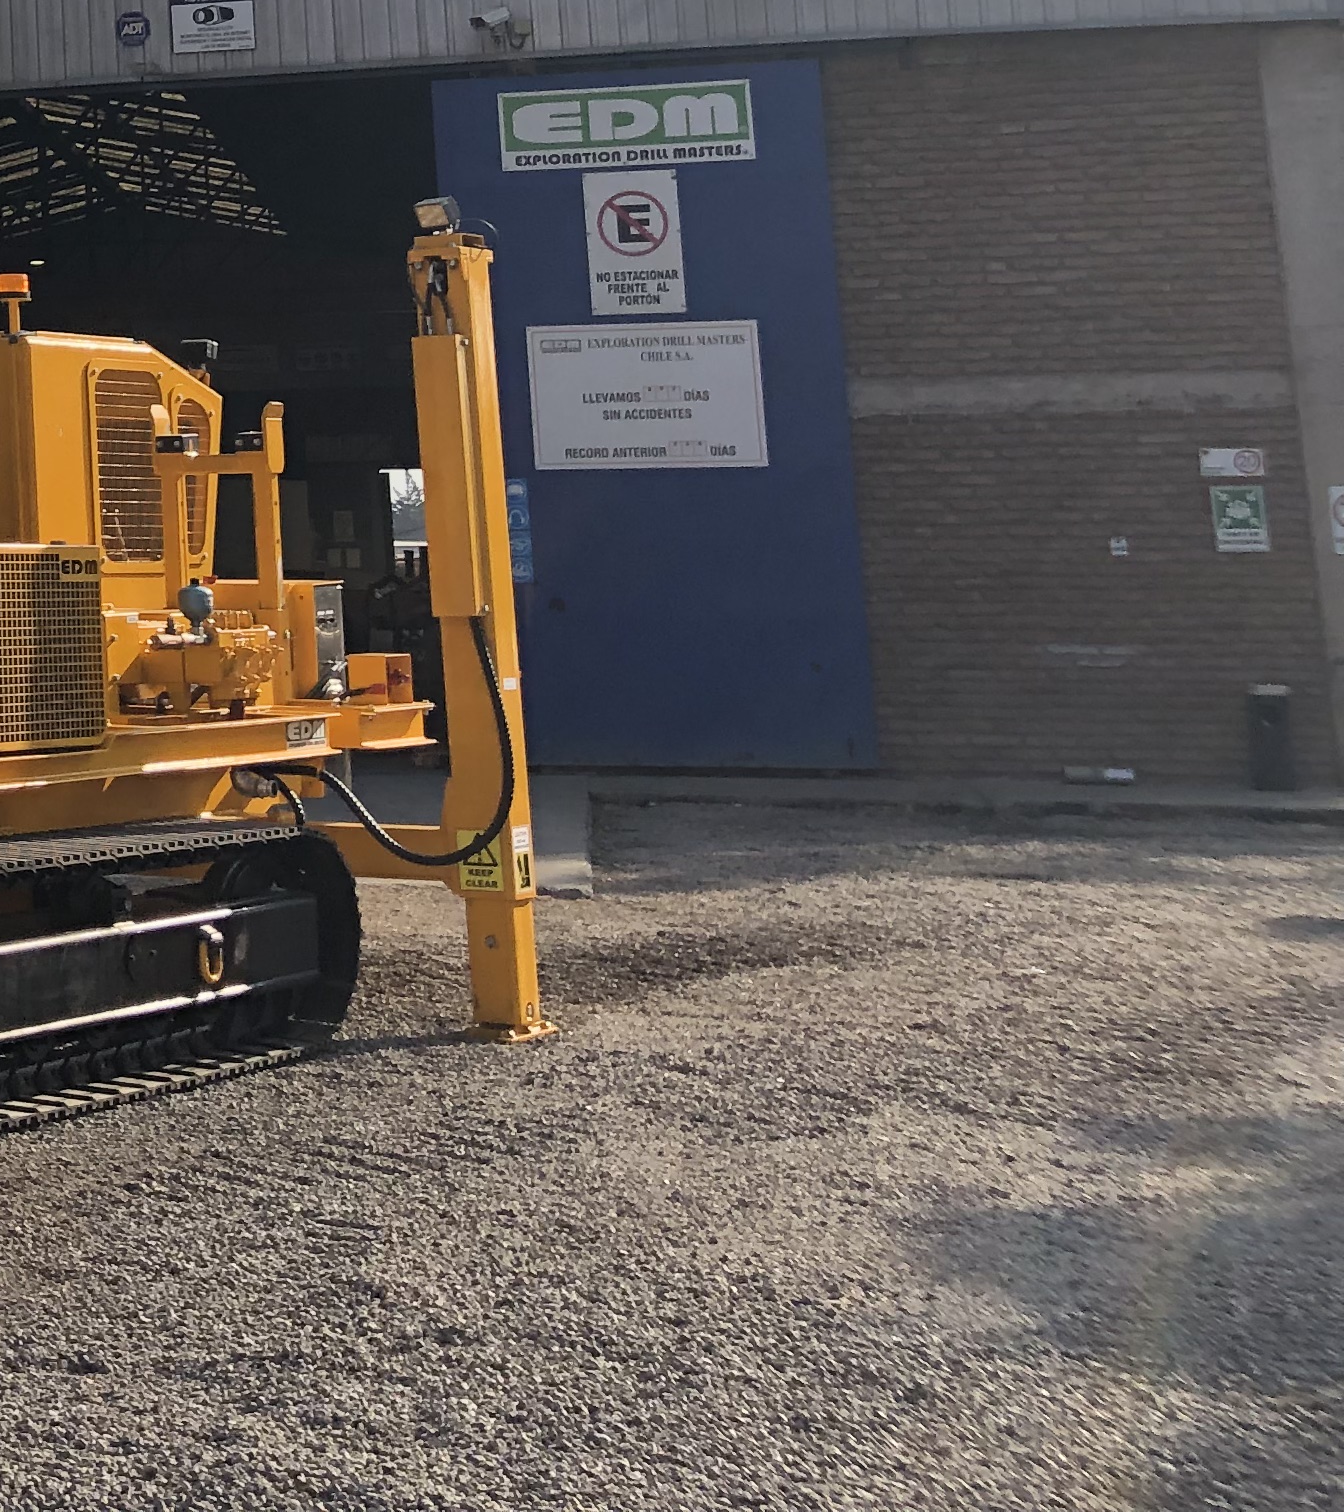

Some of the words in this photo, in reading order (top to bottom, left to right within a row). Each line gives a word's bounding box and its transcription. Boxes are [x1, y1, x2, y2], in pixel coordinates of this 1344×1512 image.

[121, 23, 144, 37] ADT
[512, 93, 739, 143] EDM
[515, 150, 621, 167] EXPLORATION
[626, 148, 669, 162] DRILL
[673, 144, 743, 159] MASTERS
[596, 272, 611, 283] NO
[614, 270, 679, 282] ESTACIONAR
[608, 283, 648, 294] FRENTE
[656, 282, 670, 292] AL
[618, 292, 661, 306] PORTÓN
[587, 337, 659, 349] EXPLORATION
[663, 336, 694, 347] DRILL
[696, 335, 745, 346] MASTERS
[640, 351, 672, 362] CHILE
[675, 351, 694, 361] S.A.
[582, 392, 641, 404] LLEVAMOS
[683, 390, 710, 402] DÍAS
[602, 409, 621, 420] SIN
[624, 408, 692, 420] ACCIDENTES
[565, 447, 609, 459] RECORD
[612, 446, 667, 458] ANTERIOR
[710, 444, 736, 456] DÍAS
[61, 559, 97, 574] EDM
[287, 719, 325, 741] EDM
